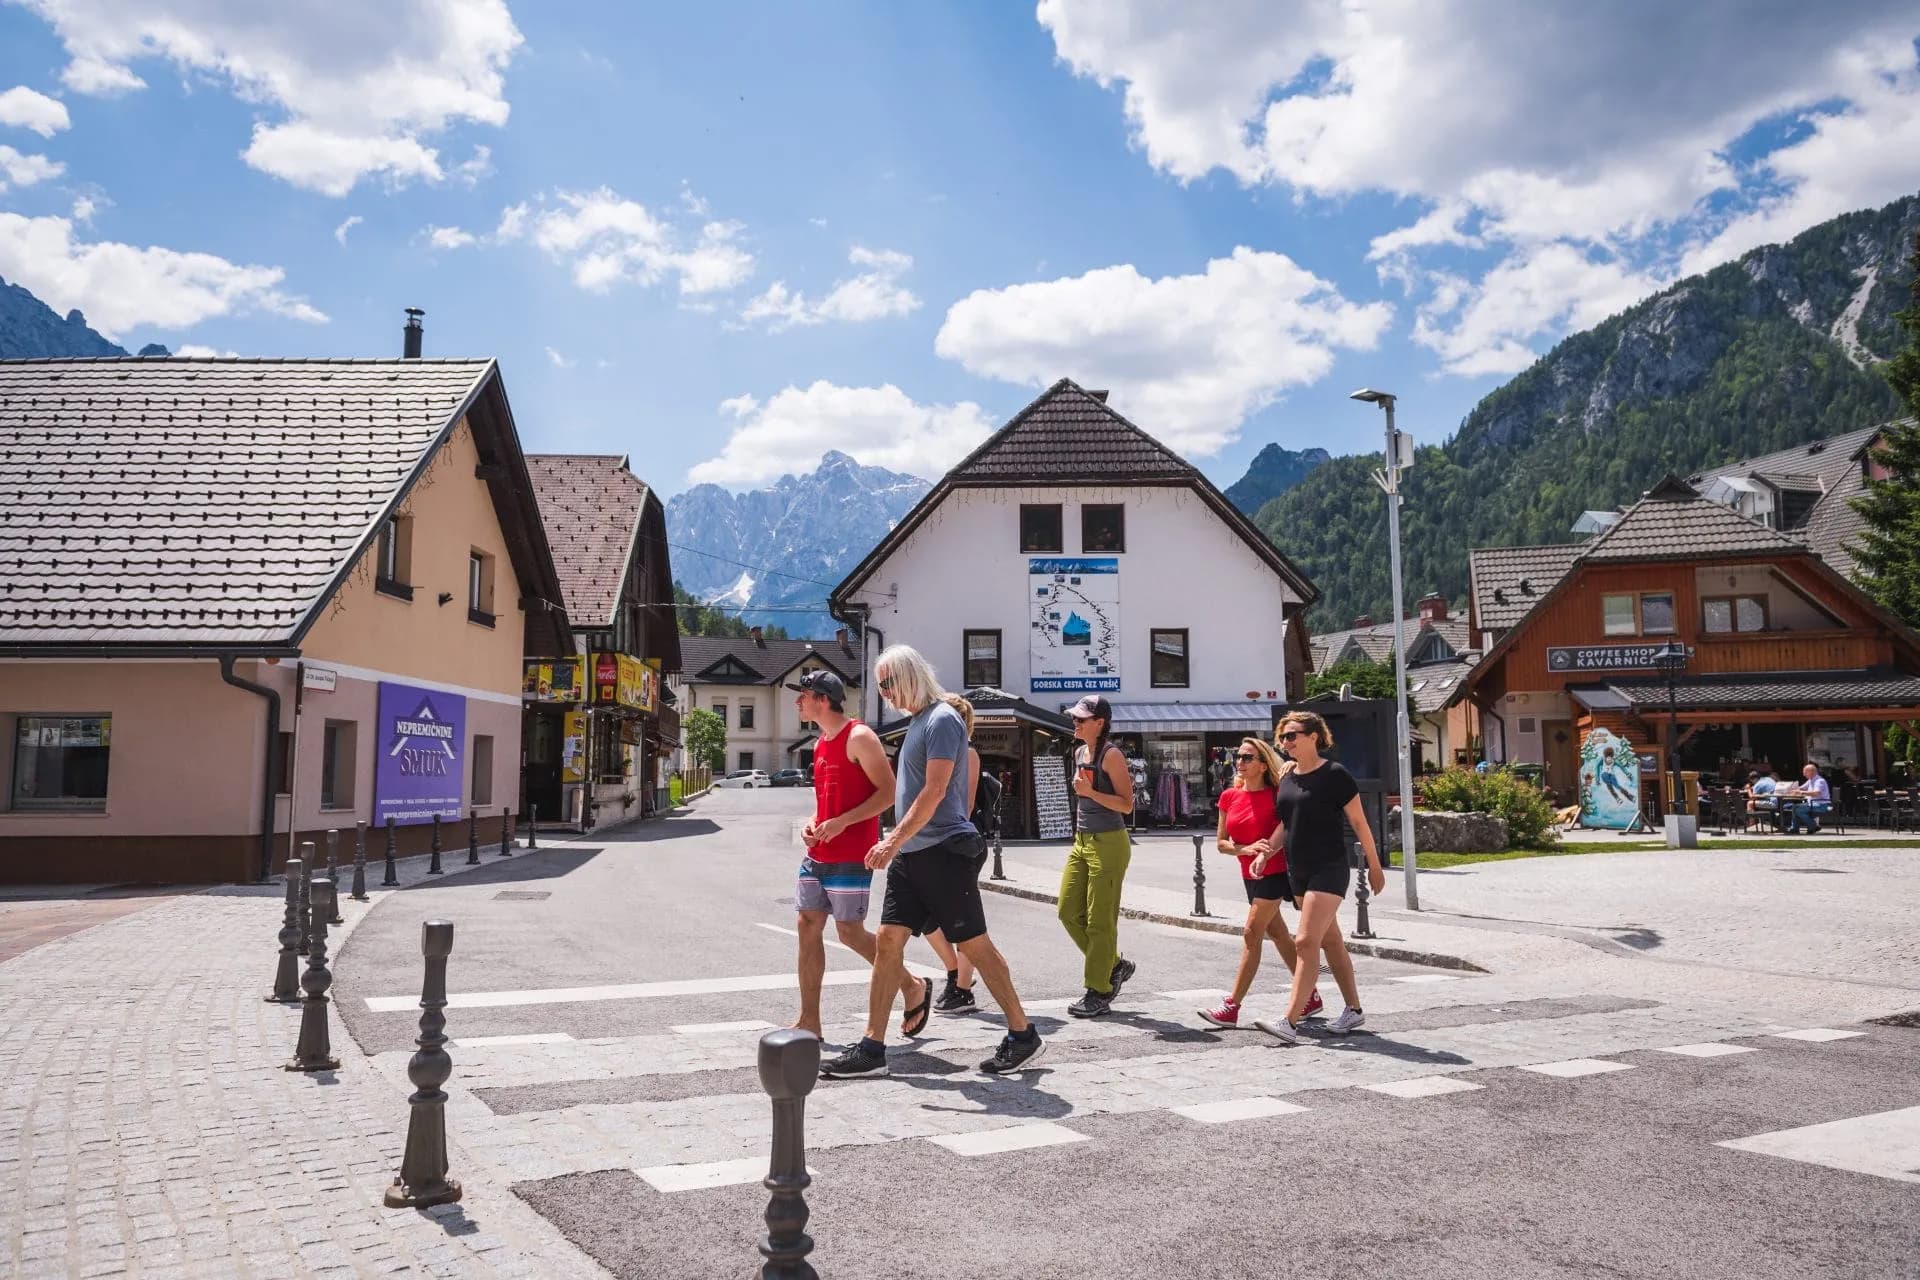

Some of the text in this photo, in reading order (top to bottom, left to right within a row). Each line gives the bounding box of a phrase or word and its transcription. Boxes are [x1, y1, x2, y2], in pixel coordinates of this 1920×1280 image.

[1578, 648, 1656, 658] COFFEE SHOP
[1577, 656, 1656, 667] KAVARNICA
[1033, 679, 1119, 689] GORSKA CESTA ČEZ VRŠIČ
[397, 721, 452, 738] NEPREMIČNINE
[400, 748, 447, 776] SMUK
